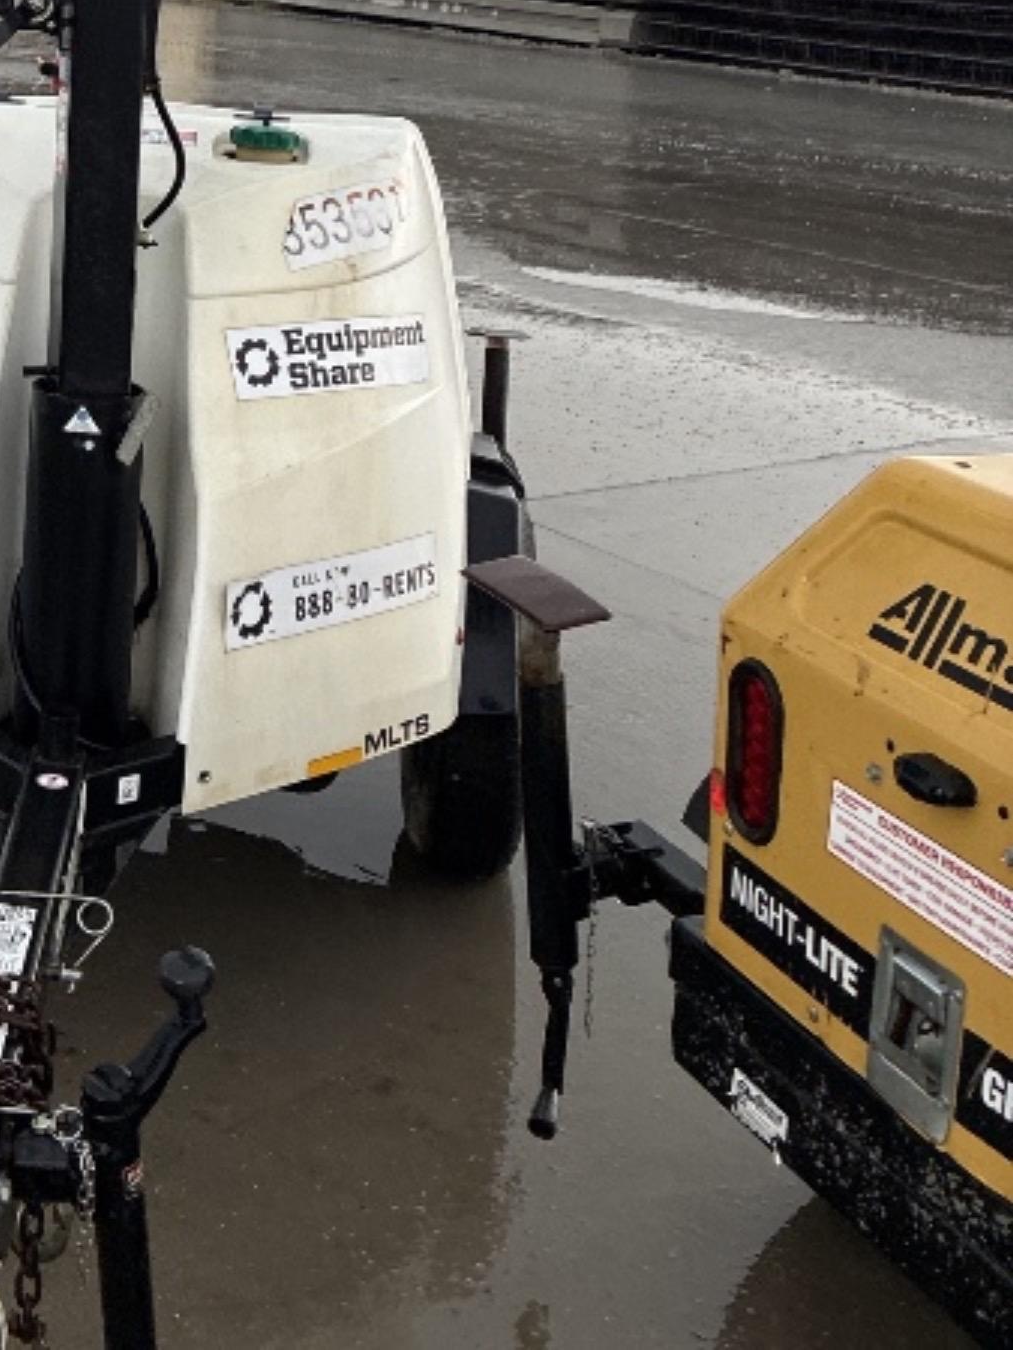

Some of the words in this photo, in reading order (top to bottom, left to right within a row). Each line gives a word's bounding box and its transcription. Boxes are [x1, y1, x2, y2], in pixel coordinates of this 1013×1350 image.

[282, 320, 425, 359] Equipment
[289, 361, 375, 389] Share
[364, 713, 430, 754] MLTS
[730, 866, 860, 998] NIGHT-LITE
